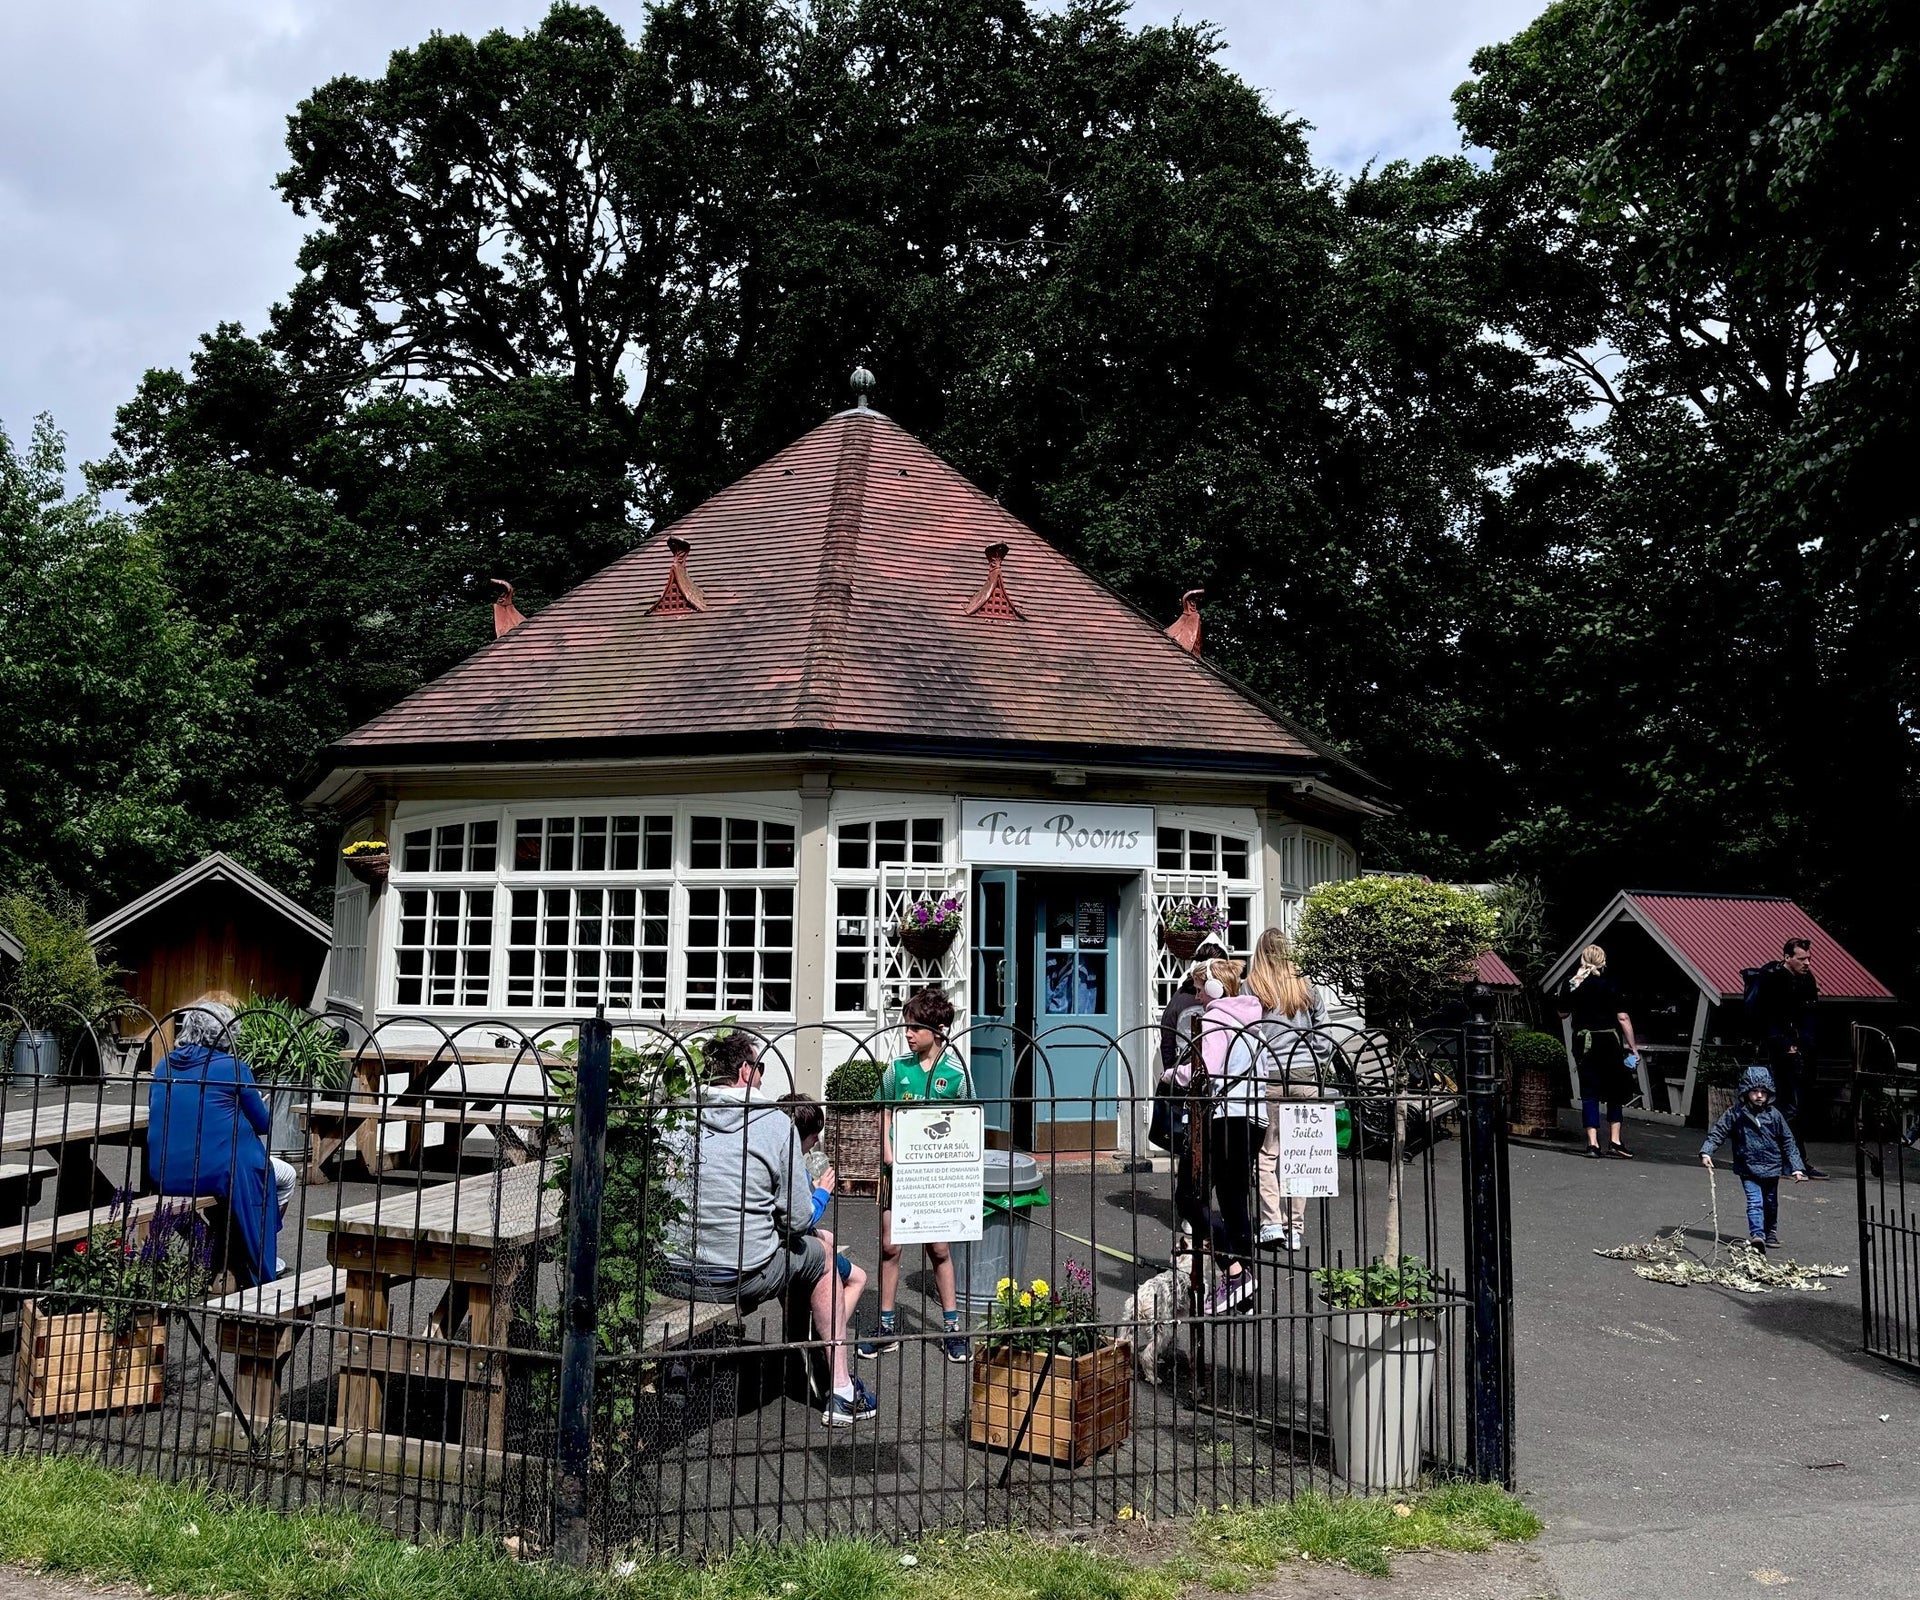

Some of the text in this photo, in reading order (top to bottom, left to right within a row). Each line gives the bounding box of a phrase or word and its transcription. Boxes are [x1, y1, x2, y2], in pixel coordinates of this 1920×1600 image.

[977, 811, 1141, 851] Tea Rooms
[1291, 1127, 1323, 1138] Toilets
[954, 1140, 970, 1150] SIÚL
[905, 1152, 924, 1160] CCTV
[934, 1151, 974, 1159] OPERATION
[1284, 1145, 1333, 1159] open from
[1284, 1163, 1333, 1174] 9.30am to
[1312, 1184, 1328, 1195] pm
